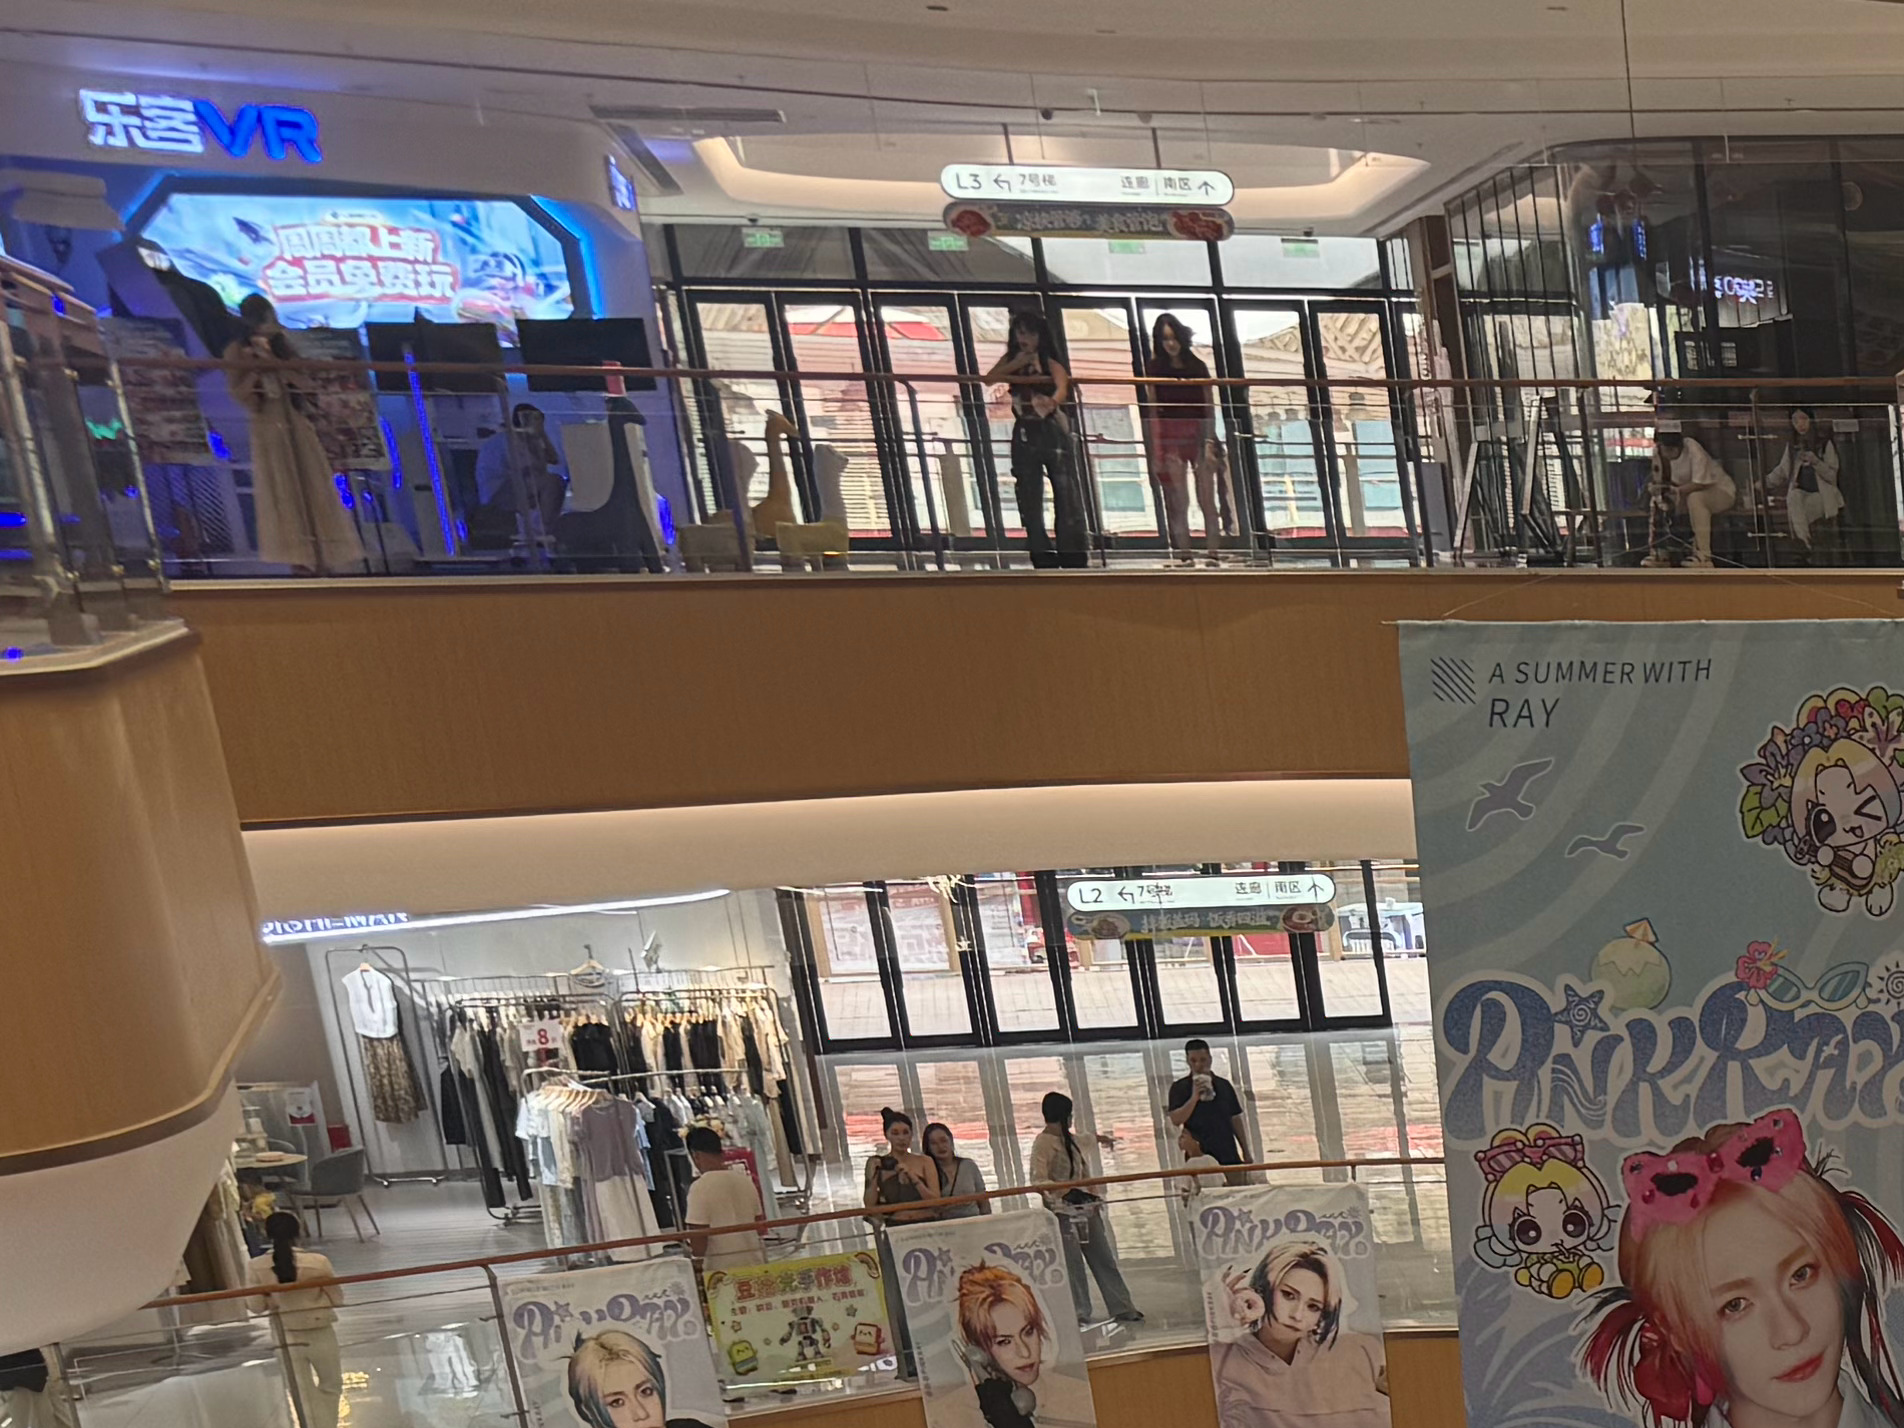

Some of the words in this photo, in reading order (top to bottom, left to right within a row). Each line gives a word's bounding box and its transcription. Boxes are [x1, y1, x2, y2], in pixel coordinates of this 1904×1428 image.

[79, 88, 322, 164] 乐客VR
[956, 172, 983, 190] L3
[1489, 663, 1505, 684] A
[1515, 661, 1634, 685] SUMMER
[1644, 658, 1712, 682] WITH
[1488, 697, 1559, 728] RAY
[1078, 887, 1103, 904] L2
